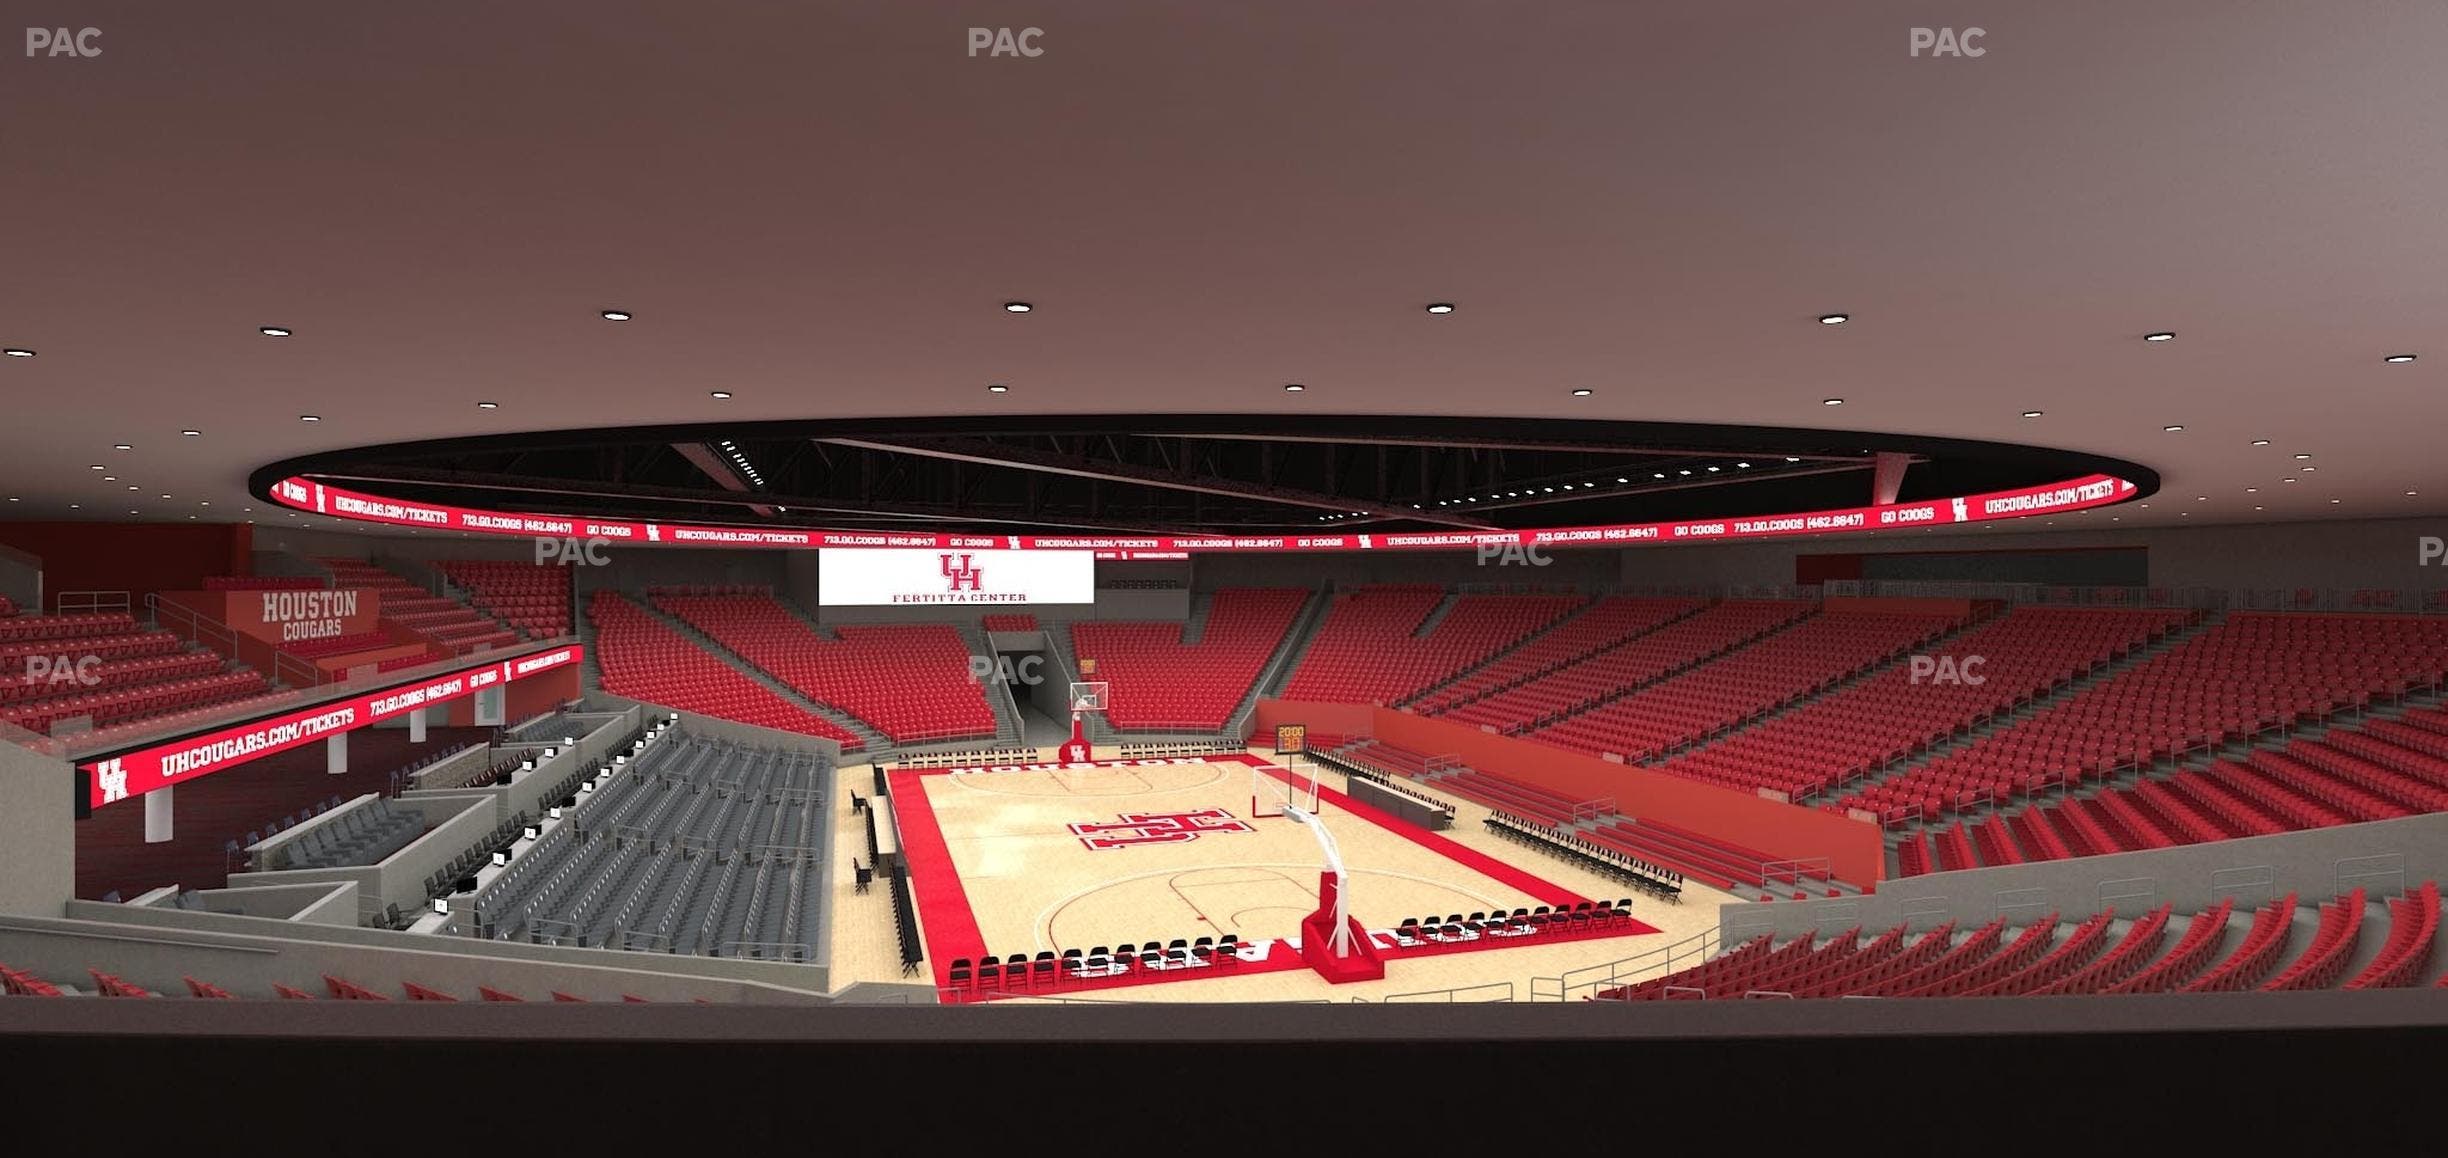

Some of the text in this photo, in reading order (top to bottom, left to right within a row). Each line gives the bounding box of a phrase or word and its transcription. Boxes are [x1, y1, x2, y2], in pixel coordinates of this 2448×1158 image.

[1881, 510, 1897, 524] GO
[586, 524, 600, 535] GO
[263, 590, 358, 622] HOUSTON
[893, 593, 1027, 603] FERTITTA CENTER
[283, 618, 342, 641] COUGARS
[161, 708, 355, 777] UHCOUGARS.COM/TICKETS
